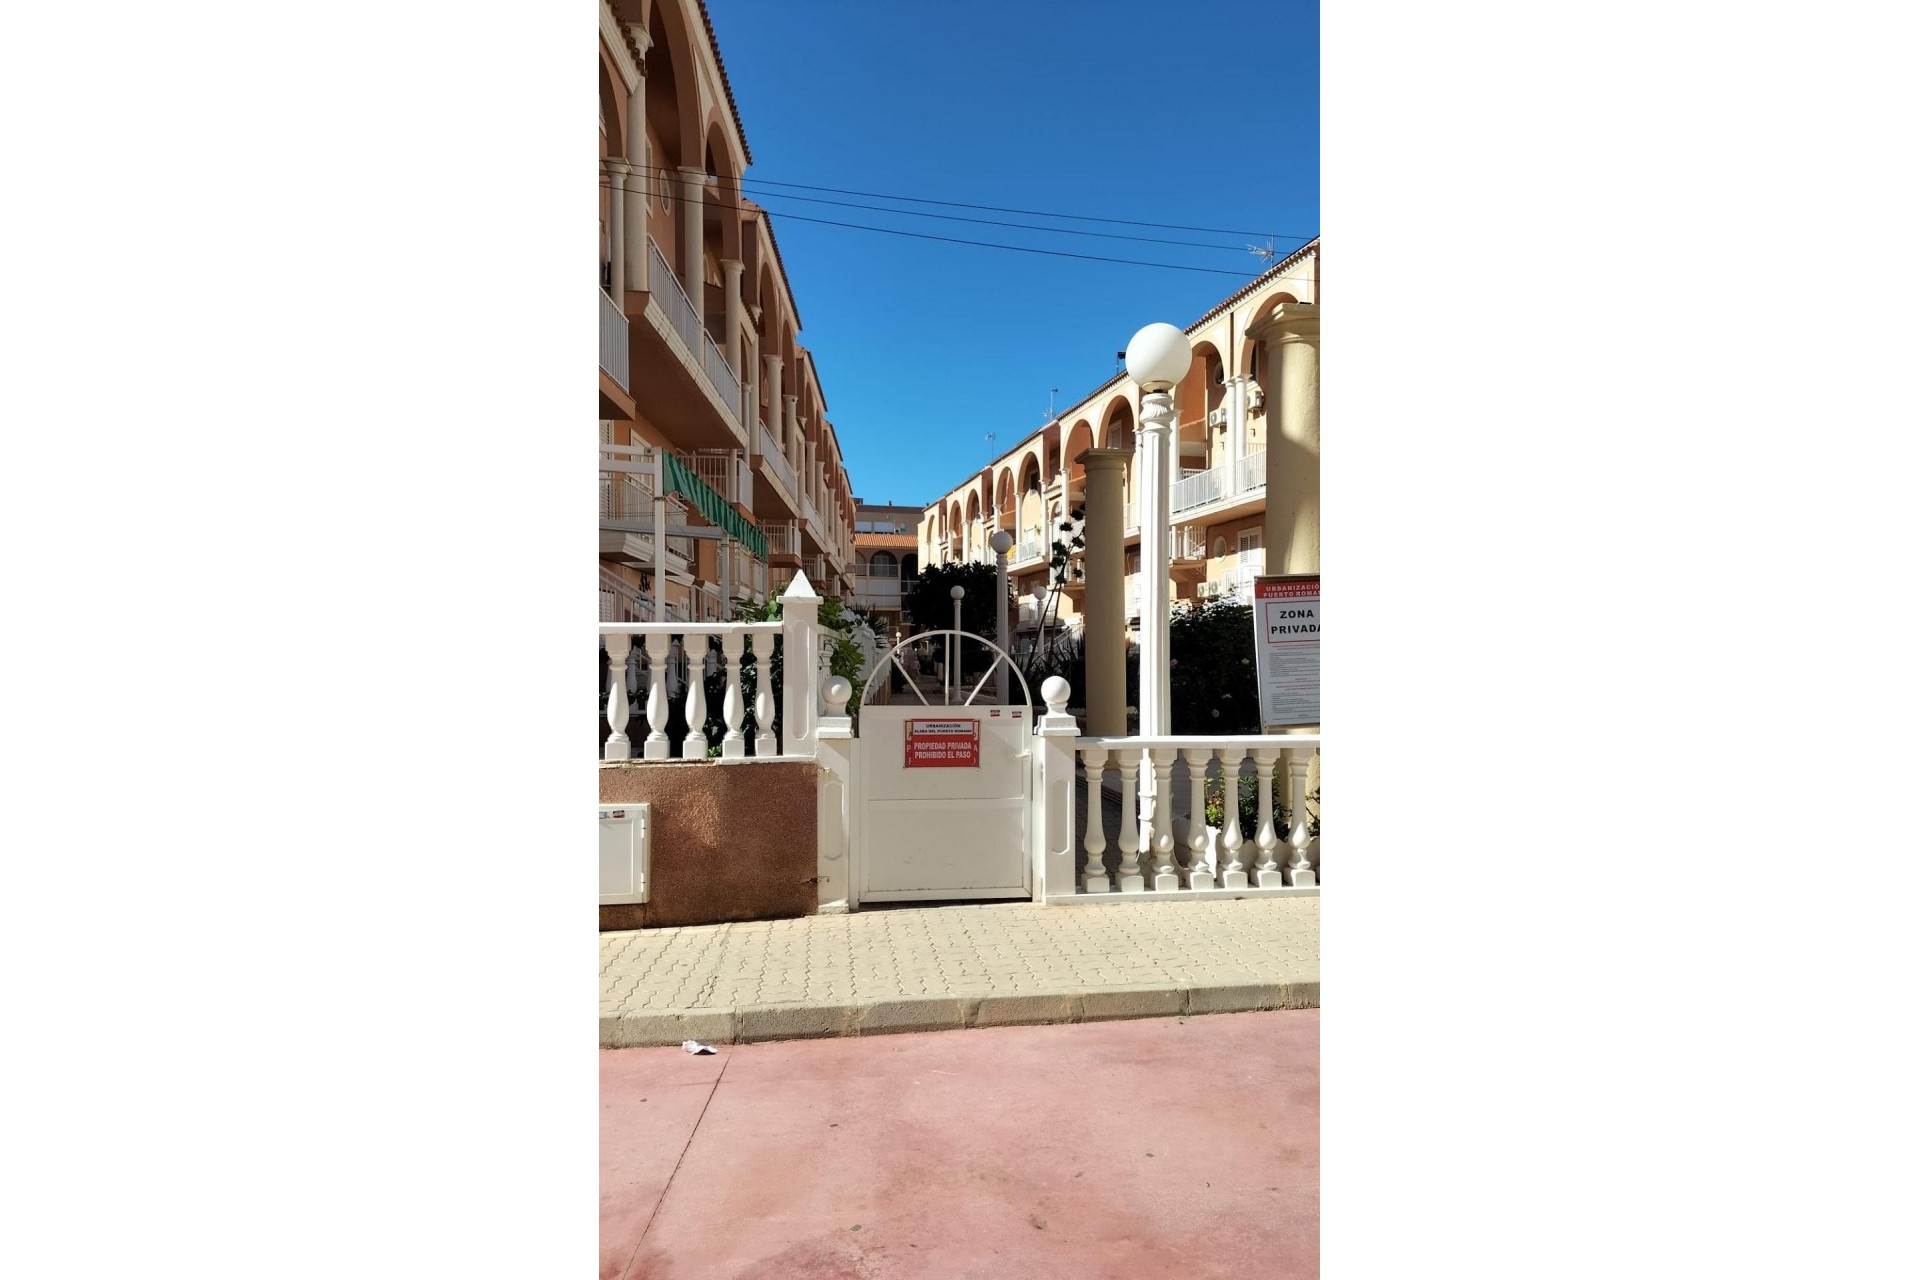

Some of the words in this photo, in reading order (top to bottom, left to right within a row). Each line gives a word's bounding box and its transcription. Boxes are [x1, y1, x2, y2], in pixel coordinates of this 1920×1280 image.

[1280, 609, 1314, 619] ZONA
[914, 742, 946, 750] PROPIEDAD
[948, 742, 972, 750] PRIVADA
[914, 751, 946, 759] PROHIBIDO
[948, 751, 954, 759] EL
